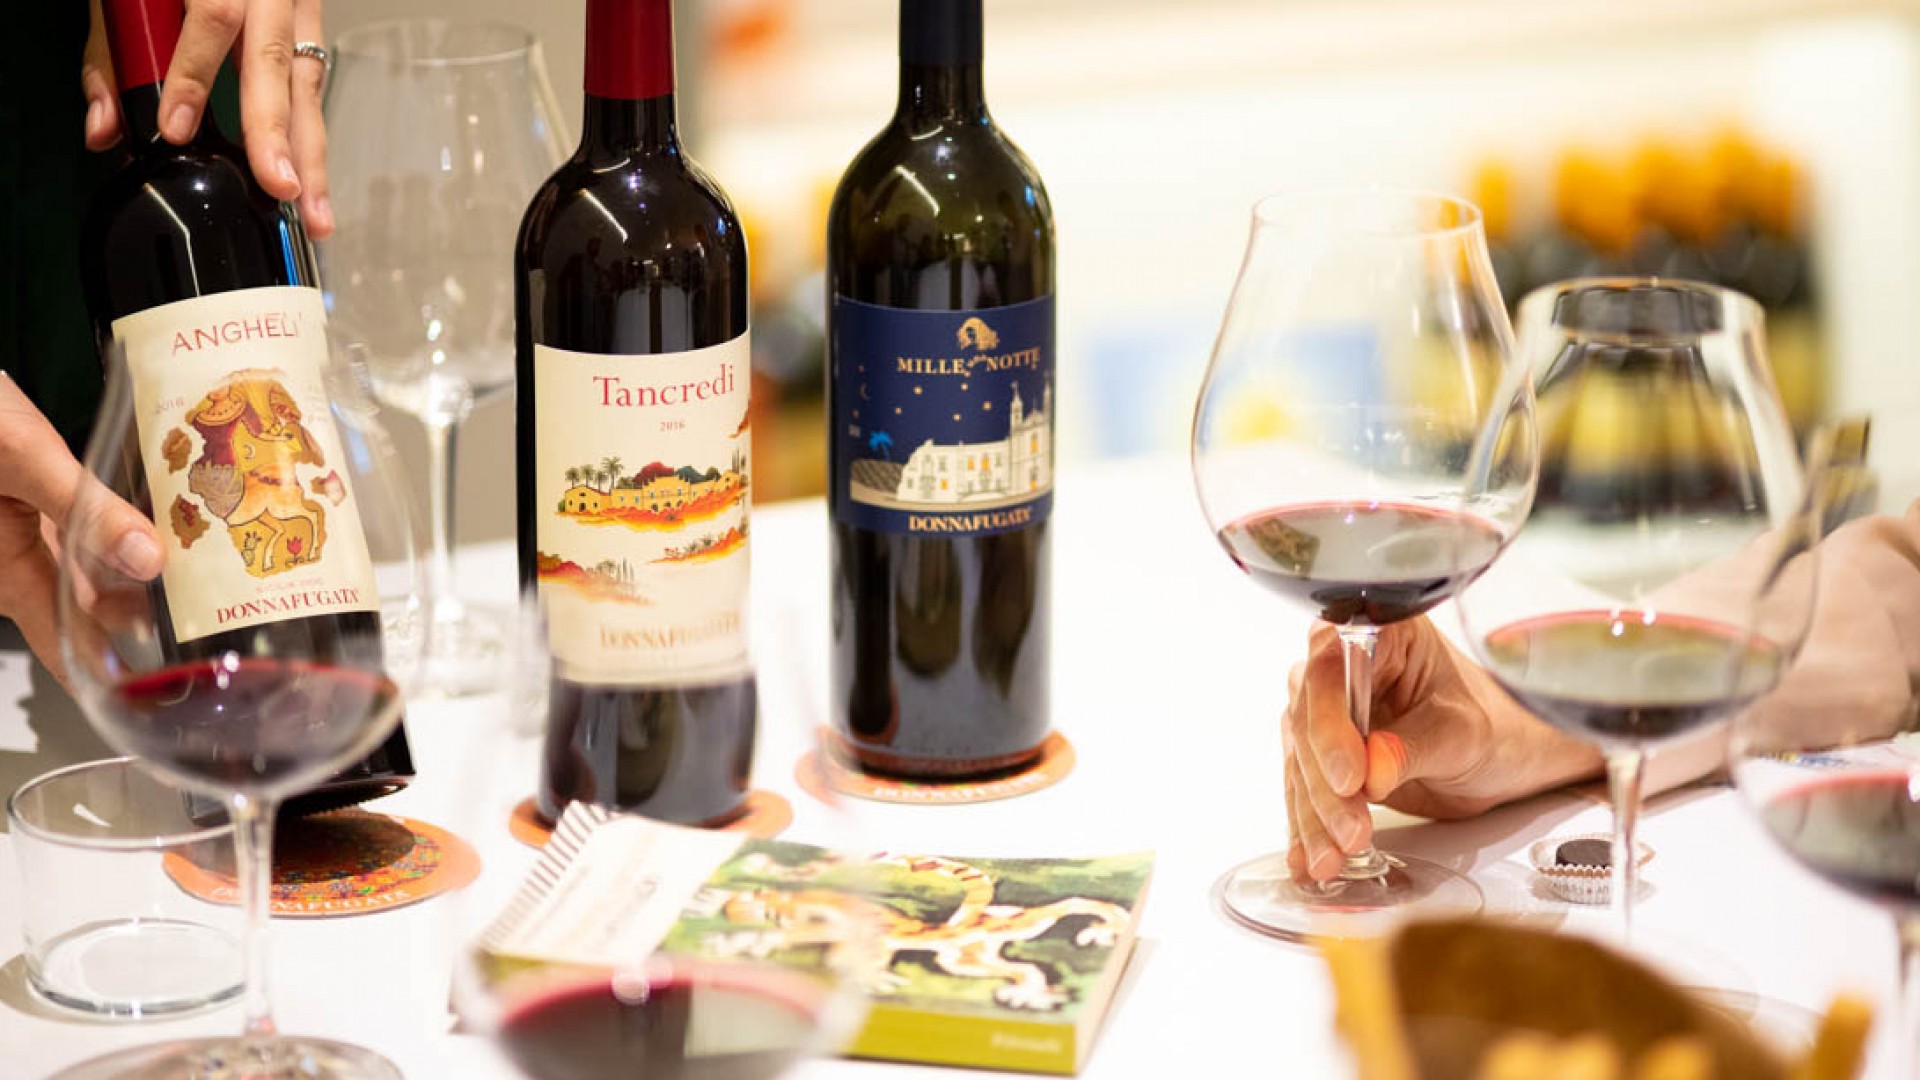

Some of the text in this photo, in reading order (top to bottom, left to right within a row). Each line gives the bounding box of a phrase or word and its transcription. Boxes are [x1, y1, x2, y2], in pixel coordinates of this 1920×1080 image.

[897, 356, 966, 374] MILLE
[986, 345, 1040, 371] NOTTE
[592, 363, 735, 407] Tancredi
[660, 419, 685, 432] 2016
[909, 505, 1032, 532] DONNAFUGATA
[216, 587, 361, 623] DONNAFUGATA
[599, 610, 741, 648] DONNAFU
